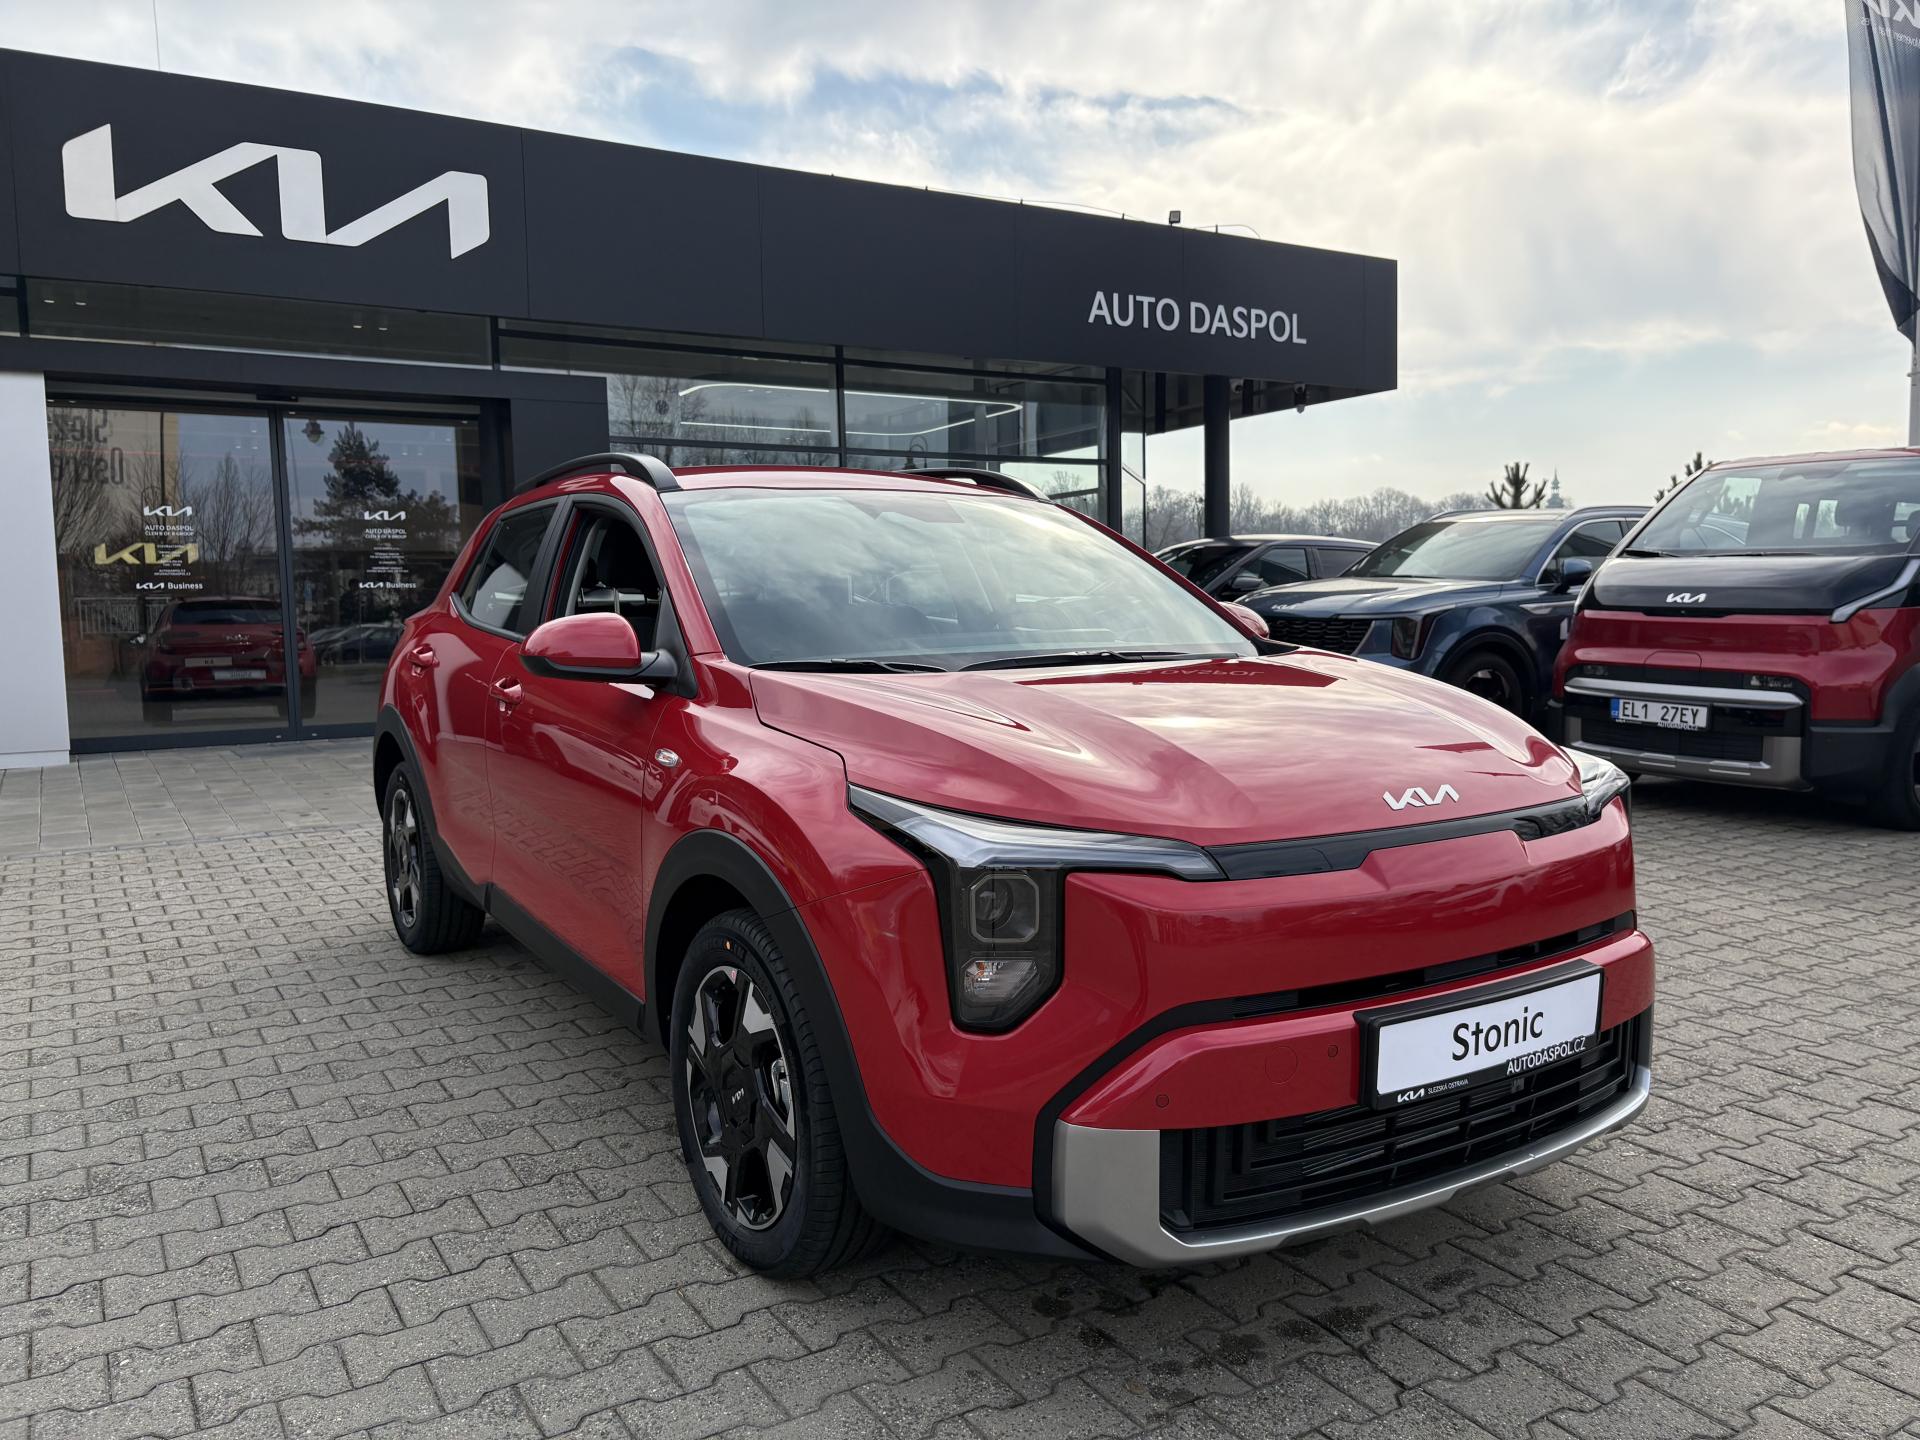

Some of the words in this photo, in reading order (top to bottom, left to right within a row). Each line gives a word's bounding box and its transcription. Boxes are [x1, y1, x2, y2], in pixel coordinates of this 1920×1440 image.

[62, 123, 490, 260] KIA
[1088, 290, 1180, 331] AUTO
[1190, 301, 1307, 344] DASPOL
[143, 505, 193, 517] KIA
[364, 510, 406, 521] KIA
[94, 542, 199, 564] KIA
[1666, 592, 1707, 603] KIA
[1622, 701, 1648, 719] EL1
[1660, 705, 1699, 725] 27EY
[1382, 784, 1460, 811] KIA
[1452, 1006, 1544, 1061] Stonic
[1506, 1037, 1586, 1075] AUTODASPOL.CZ
[1397, 1088, 1425, 1103] KIA
[1448, 1078, 1469, 1089] OSTRAVA
